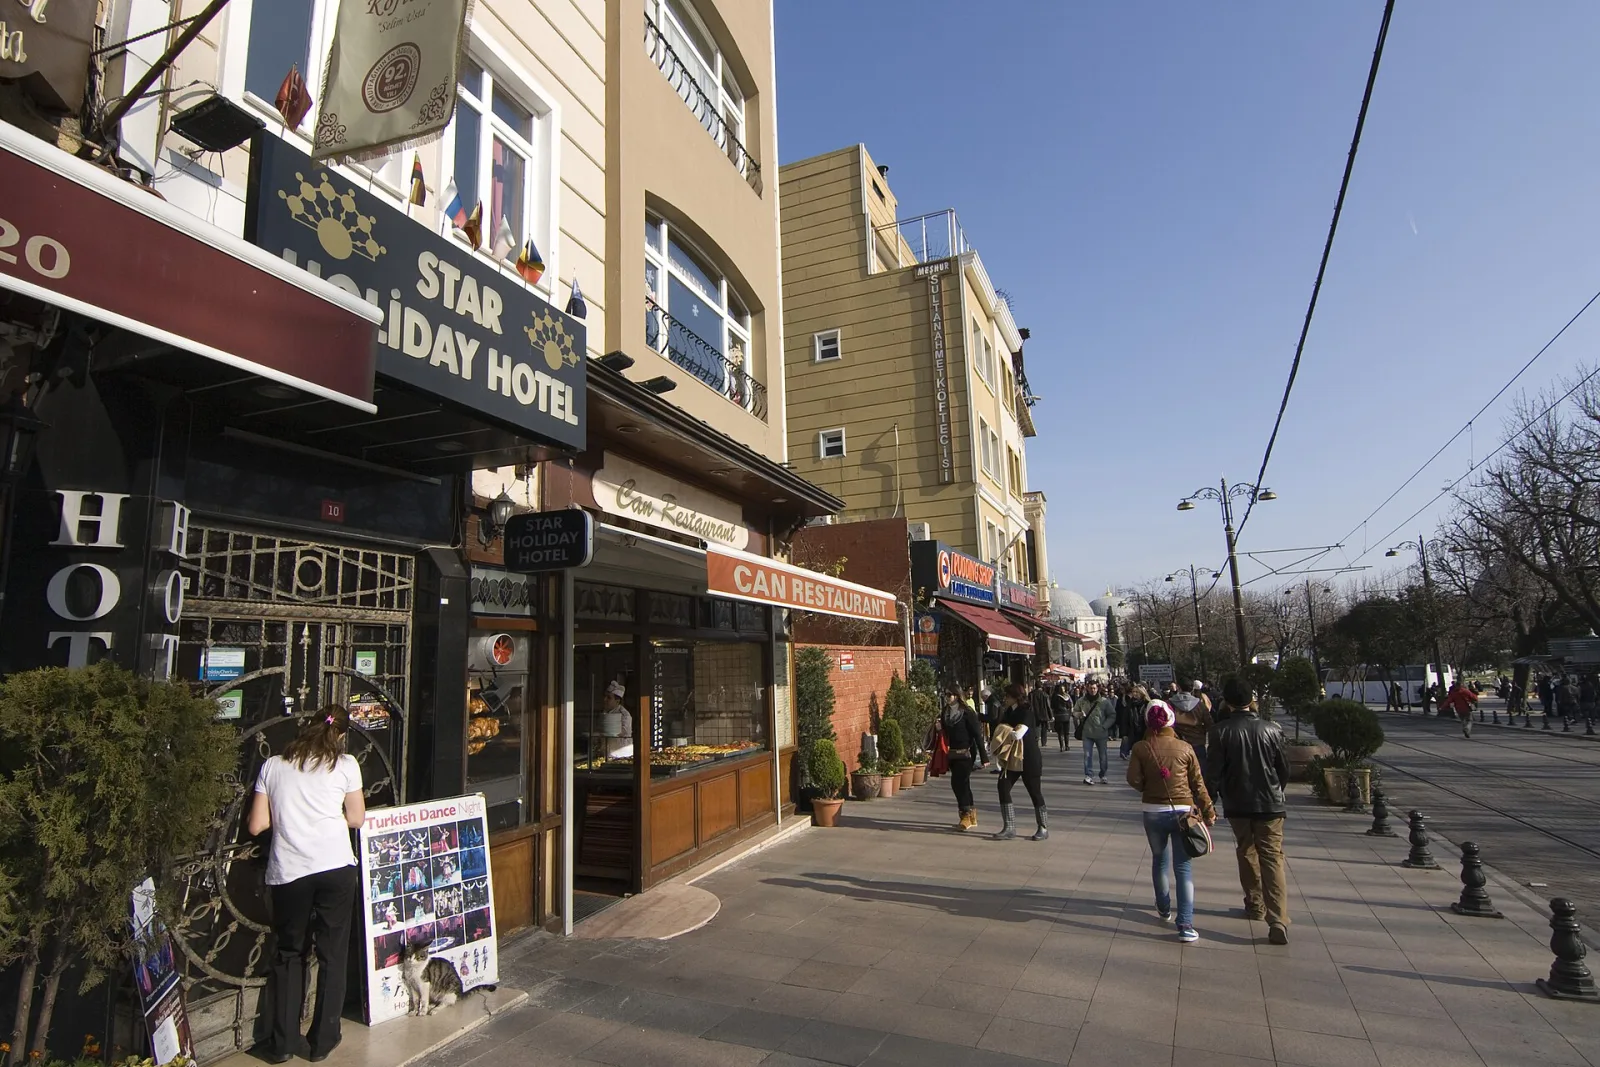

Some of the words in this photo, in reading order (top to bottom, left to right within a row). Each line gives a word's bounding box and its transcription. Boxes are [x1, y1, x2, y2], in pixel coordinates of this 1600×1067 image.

[416, 250, 504, 335] STAR
[487, 347, 579, 426] HOTEL
[328, 505, 340, 517] 10
[525, 516, 563, 532] STAR
[615, 478, 654, 518] Can
[661, 493, 736, 543] Restaurant
[519, 548, 569, 565] HOTEL
[733, 564, 787, 600] CAN
[792, 577, 887, 618] RESTAURANT
[365, 811, 416, 830] Turkish
[419, 806, 456, 821] Dance
[458, 801, 482, 817] Night
[464, 975, 485, 987] Center
